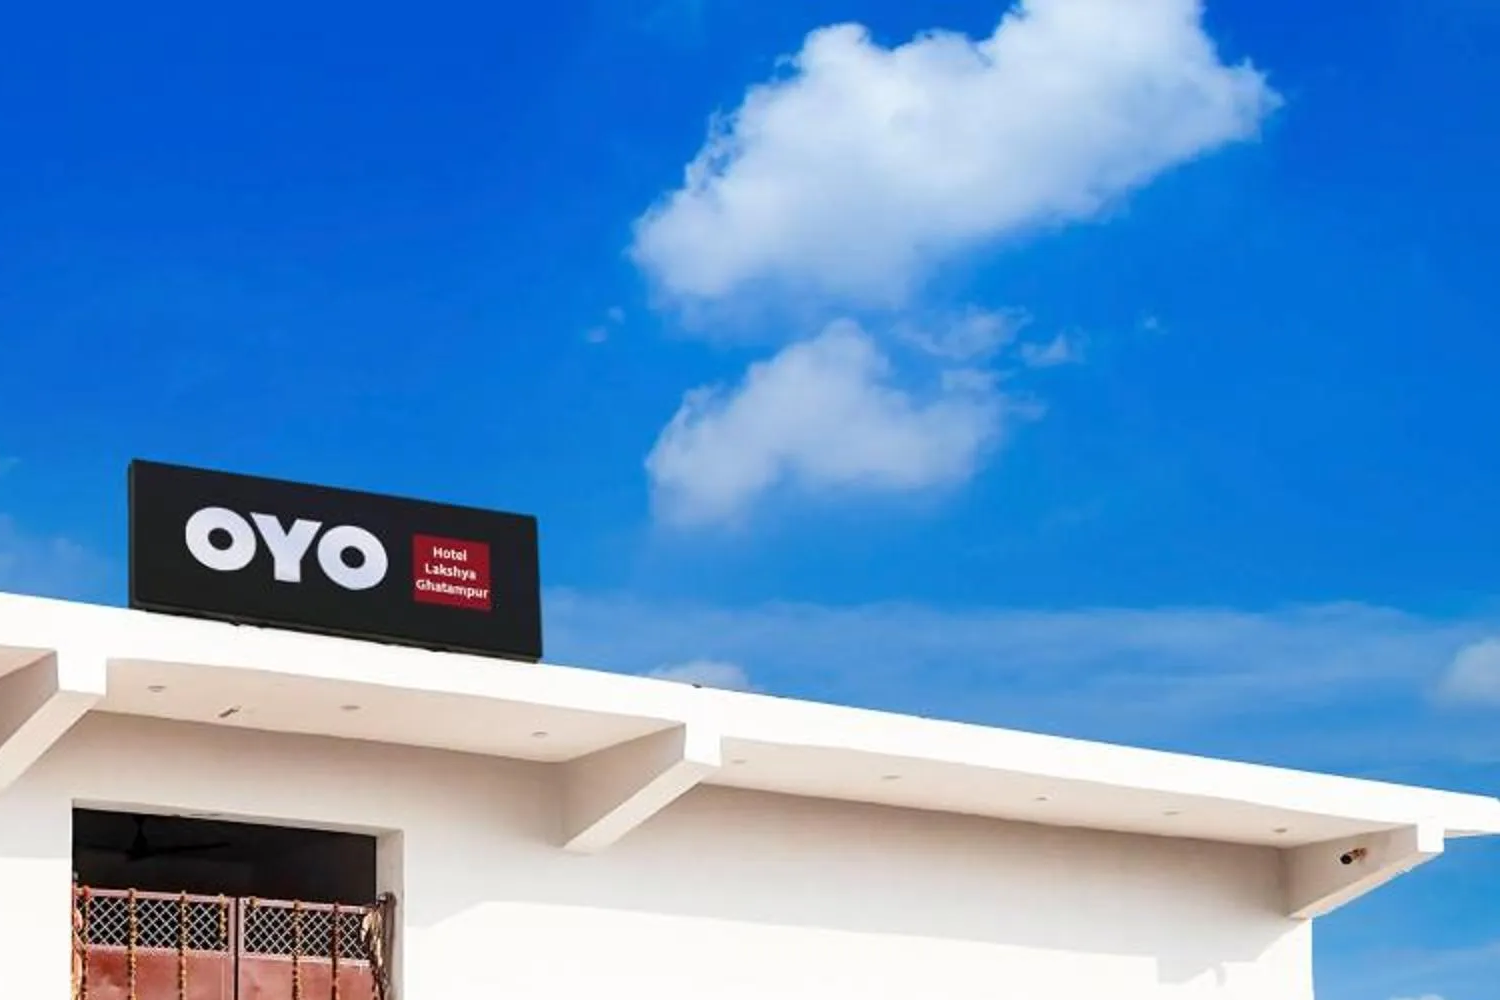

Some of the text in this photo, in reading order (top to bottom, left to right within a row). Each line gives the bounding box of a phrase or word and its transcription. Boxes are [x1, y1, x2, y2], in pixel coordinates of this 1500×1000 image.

[185, 506, 389, 591] OYO
[433, 546, 467, 562] Hotel
[425, 562, 476, 581] Lakshya
[415, 579, 488, 599] Ghatampur
